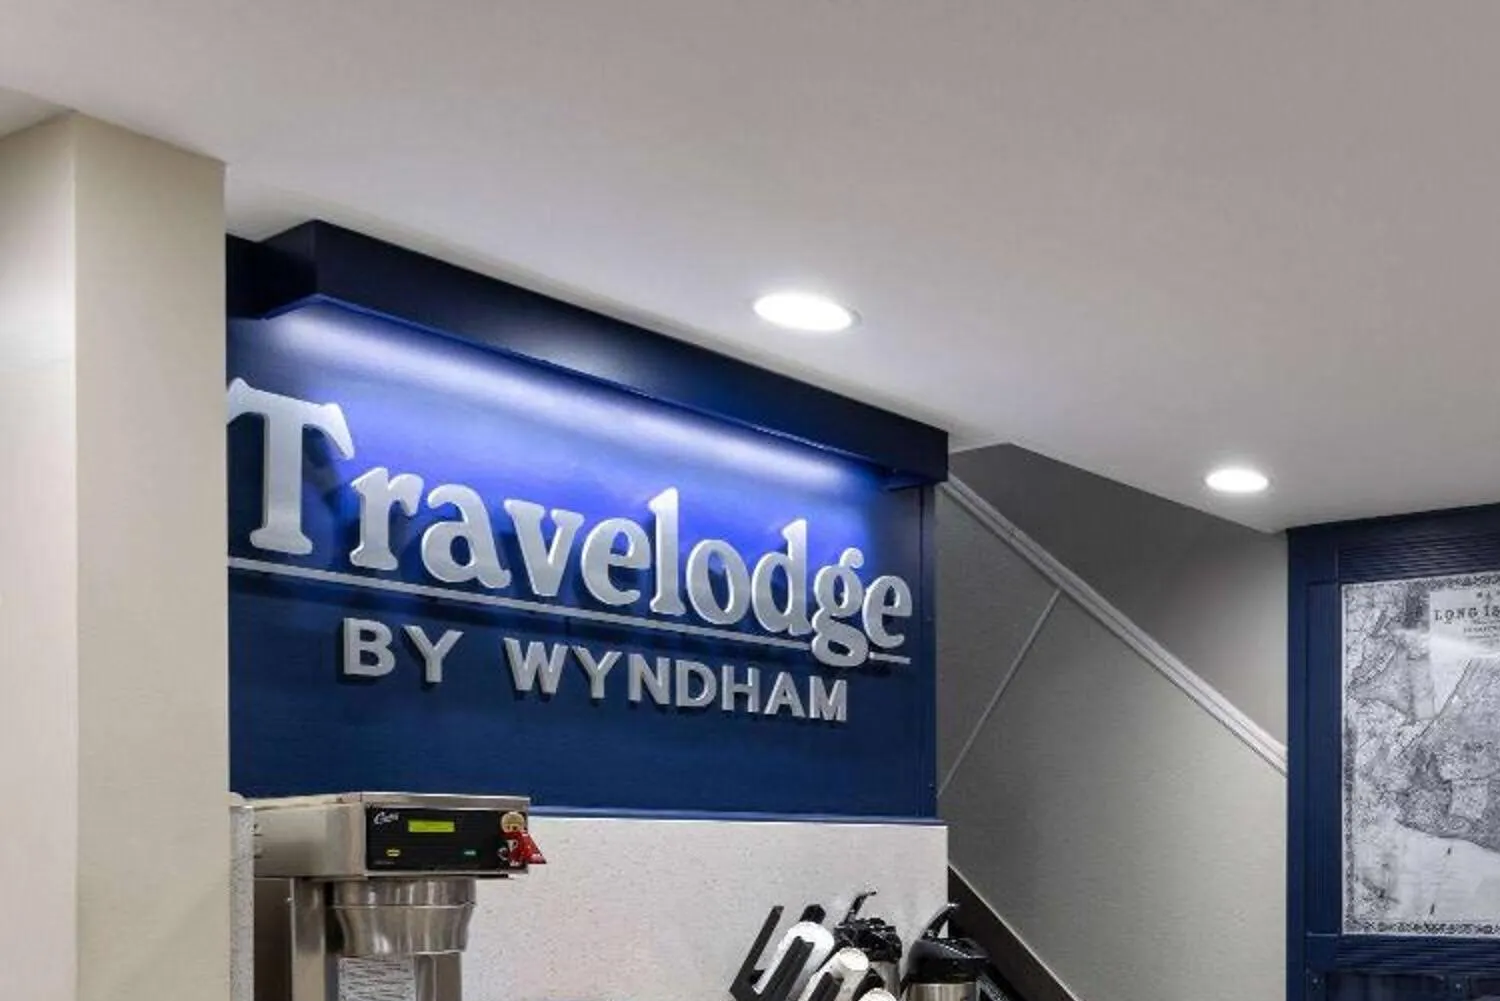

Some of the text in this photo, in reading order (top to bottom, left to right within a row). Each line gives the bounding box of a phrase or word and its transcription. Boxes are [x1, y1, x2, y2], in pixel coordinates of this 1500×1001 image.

[228, 377, 912, 667] Travelodge
[1434, 607, 1478, 621] LONG
[343, 617, 848, 722] BY WYNDHAM
